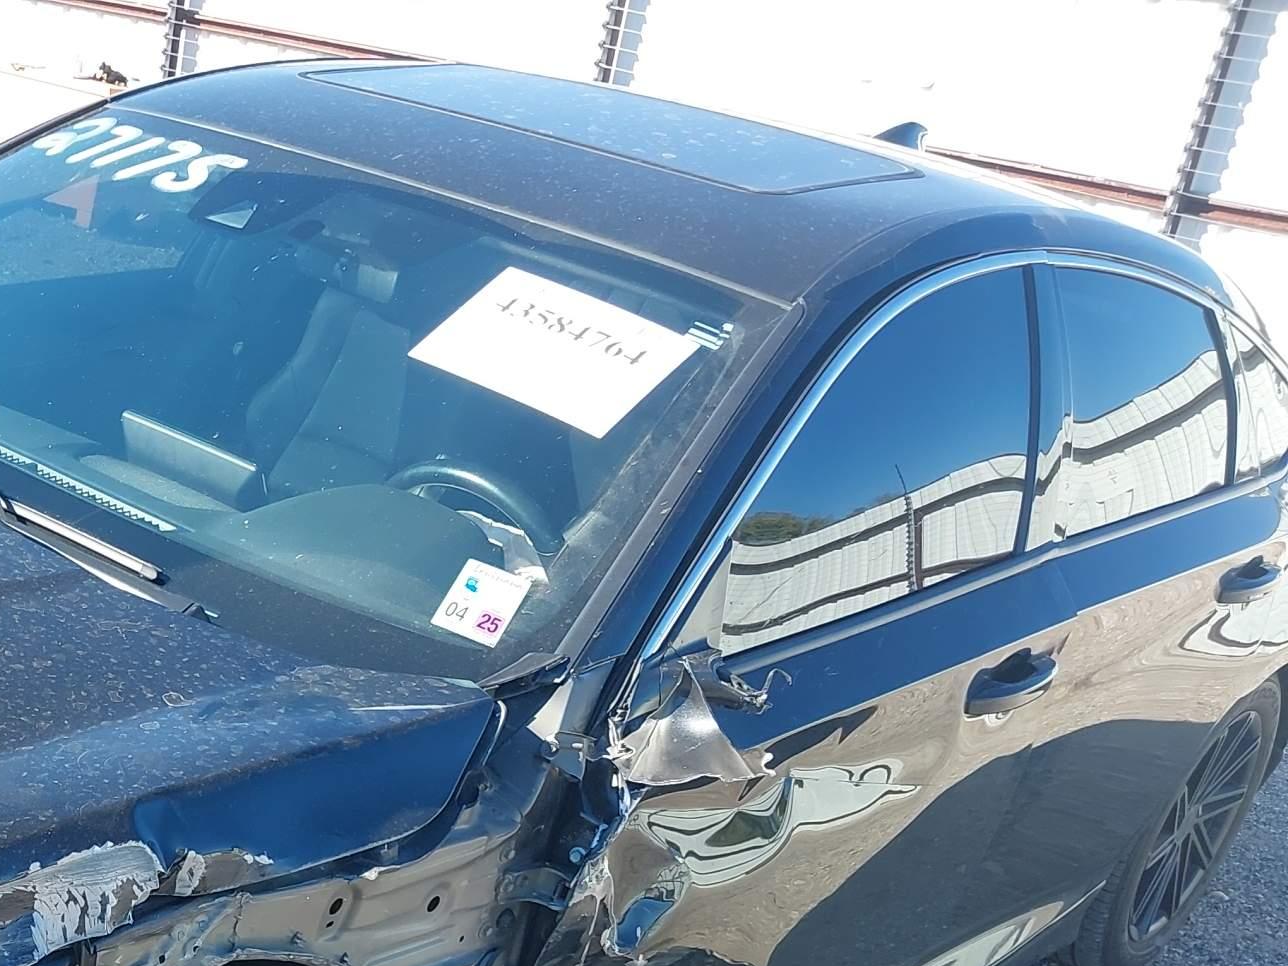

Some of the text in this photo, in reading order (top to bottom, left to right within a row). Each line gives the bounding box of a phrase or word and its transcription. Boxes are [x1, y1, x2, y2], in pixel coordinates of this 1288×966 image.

[31, 116, 249, 193] 27175
[495, 297, 648, 366] 43584764
[445, 601, 502, 633] 04 25
